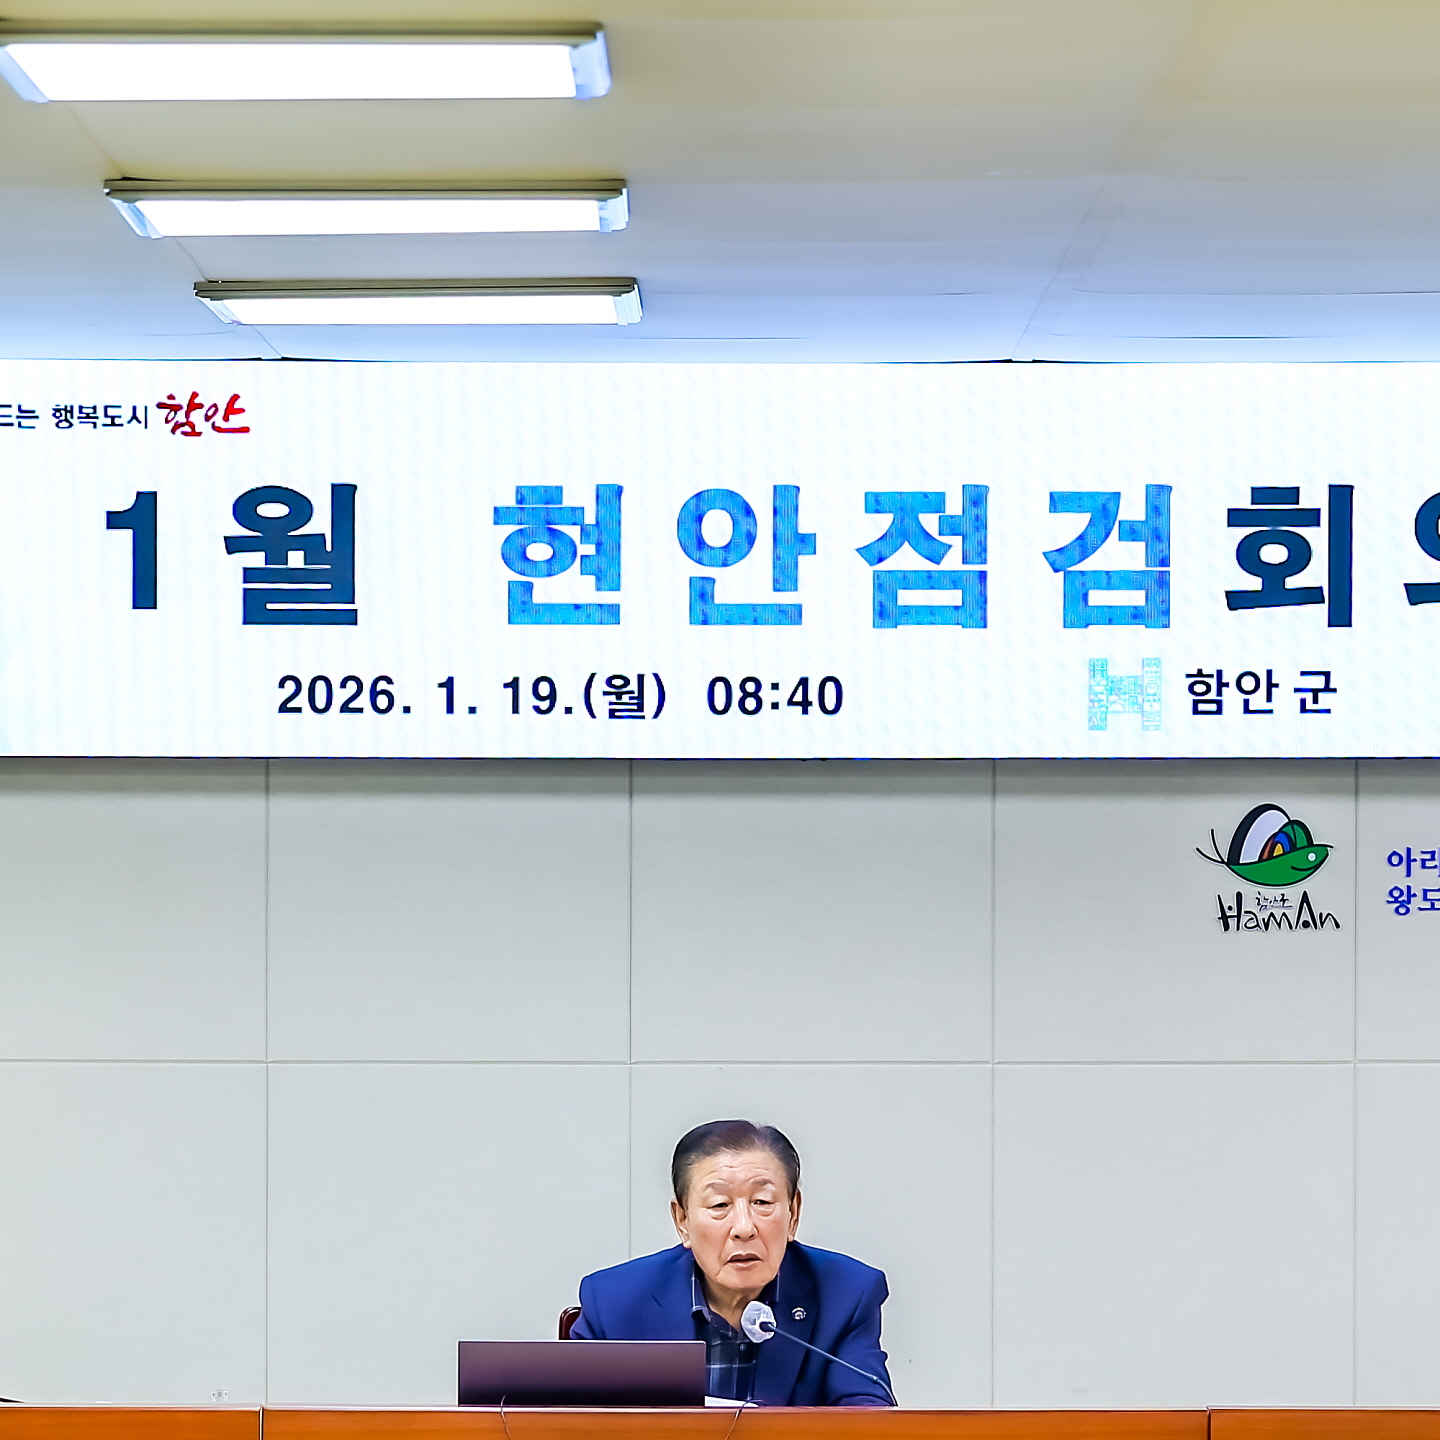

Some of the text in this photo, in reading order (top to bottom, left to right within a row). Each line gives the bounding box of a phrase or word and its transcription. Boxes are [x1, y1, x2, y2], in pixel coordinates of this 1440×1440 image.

[51, 404, 149, 430] 행복도시
[156, 391, 251, 437] 함안
[105, 482, 359, 626] 1월
[277, 674, 411, 716] 2026.
[437, 675, 477, 715] 1.
[706, 675, 844, 716] 08:40
[1216, 889, 1342, 933] HamAn
